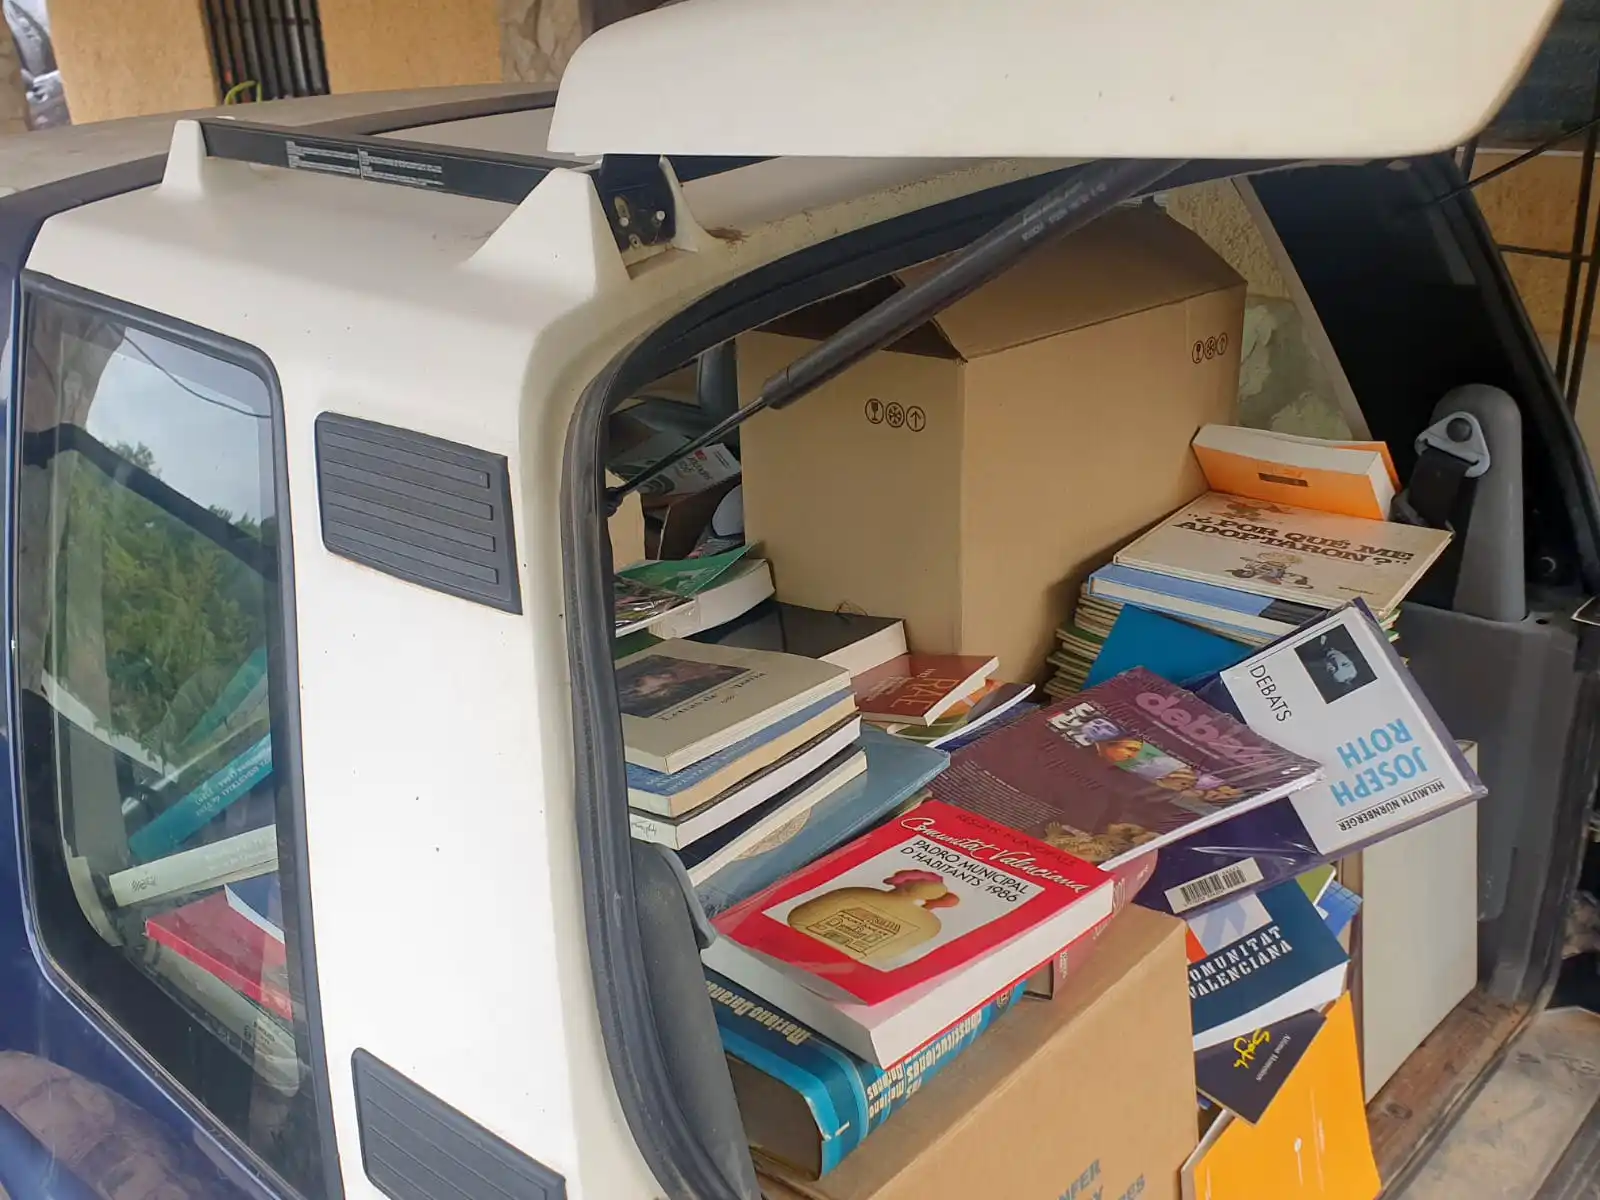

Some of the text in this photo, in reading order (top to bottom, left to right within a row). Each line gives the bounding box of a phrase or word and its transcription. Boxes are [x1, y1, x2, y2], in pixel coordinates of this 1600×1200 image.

[1359, 544, 1414, 562] ME
[1249, 665, 1292, 723] DEBATS
[1336, 718, 1413, 769] ROTH
[1330, 746, 1427, 807] JOSEPH
[1338, 780, 1445, 831] HELMUTH NÜRNBERGER
[900, 817, 1090, 893] Comunitat Valenciana
[962, 860, 1030, 895] MUNICIPAL
[984, 884, 1018, 903] 1986
[1187, 925, 1281, 982] OMUNITAT
[1188, 939, 1293, 999] VALENCIANA
[749, 1006, 812, 1046] Mariano
